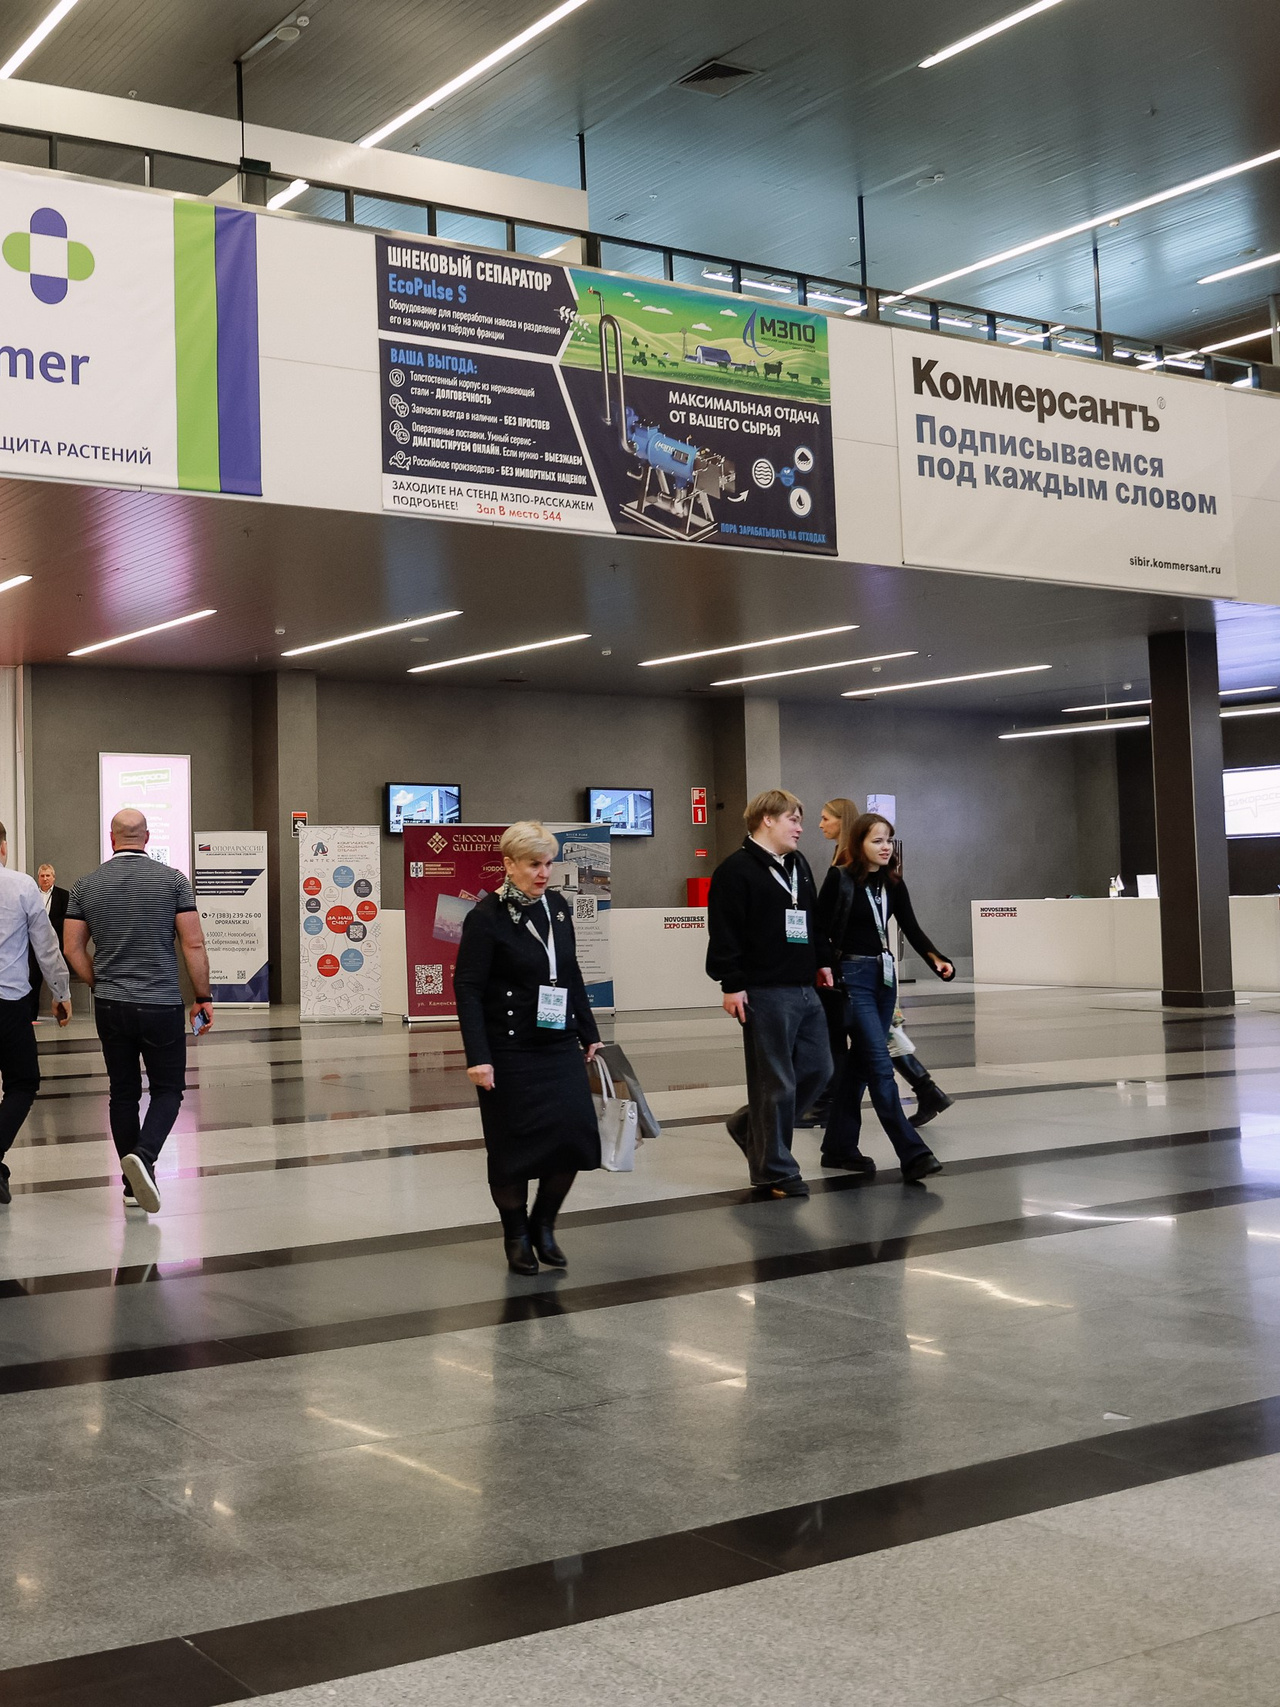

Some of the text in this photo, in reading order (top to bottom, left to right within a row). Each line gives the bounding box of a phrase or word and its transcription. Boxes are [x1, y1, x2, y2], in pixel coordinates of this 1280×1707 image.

[387, 245, 552, 292] ШНЕКОВЫЙ СЕПАРАТОР
[388, 273, 467, 304] EcoPulse S
[389, 298, 561, 336] Оборудование для переработки навоза и разделения
[389, 315, 402, 325] его
[402, 317, 412, 327] на
[412, 318, 441, 332] жидкую
[441, 323, 447, 332] и
[760, 316, 816, 344] МЗПО
[390, 347, 478, 375] ВАША ВЫГОДА:
[409, 370, 535, 398] Толстостенный корпус из нержавеющей
[410, 386, 430, 397] стали
[435, 388, 492, 405] ДОЛГОВЕЧНОСТЬ
[911, 356, 1160, 432] Коммерсантъ
[411, 402, 442, 417] Запчасти
[442, 409, 465, 421] всегда
[465, 412, 471, 421] в
[471, 413, 498, 424] наличии
[503, 415, 517, 427] БЕЗ
[517, 417, 551, 431] ПРОСТОЕВ
[668, 390, 820, 425] МАКСИМАЛЬНАЯ ОТДАЧА
[411, 421, 455, 437] Оперативные
[455, 429, 487, 441] поставки.
[487, 430, 510, 443] Умный
[509, 436, 532, 447] сервис
[669, 409, 781, 438] ОТ ВАШЕГО СЫРЬЯ
[57, 441, 151, 465] РАСТЕНИЙ
[412, 435, 471, 453] ДИАГНОСТИРУЕМ
[472, 442, 502, 456] ОНЛАЙН.
[502, 446, 518, 458] Если
[518, 450, 539, 461] нужно
[544, 451, 585, 466] ВЫЕЗЖАЕМ
[915, 413, 1164, 479] Подписываемся
[412, 455, 450, 470] Российское
[450, 461, 495, 475] производство
[500, 465, 514, 477] БЕЗ
[514, 467, 557, 482] ИМПОРТНЫХ
[556, 472, 587, 485] НАЦЕНОК
[392, 480, 595, 512] ЗАХОДИТЕ НА СТЕНД МЗПО-РАССКАЖЕМ
[917, 454, 1217, 516] под каждым словом
[392, 495, 459, 511] ПОДРОБНЕЕ!
[476, 502, 562, 522] Зал В место 544
[720, 522, 826, 544] ПОРА ЗАРАБАТЫВАТЬ НА ОТХОДАХ
[1129, 555, 1221, 575] sibir.kommersant.ru
[452, 843, 492, 852] GALLERY
